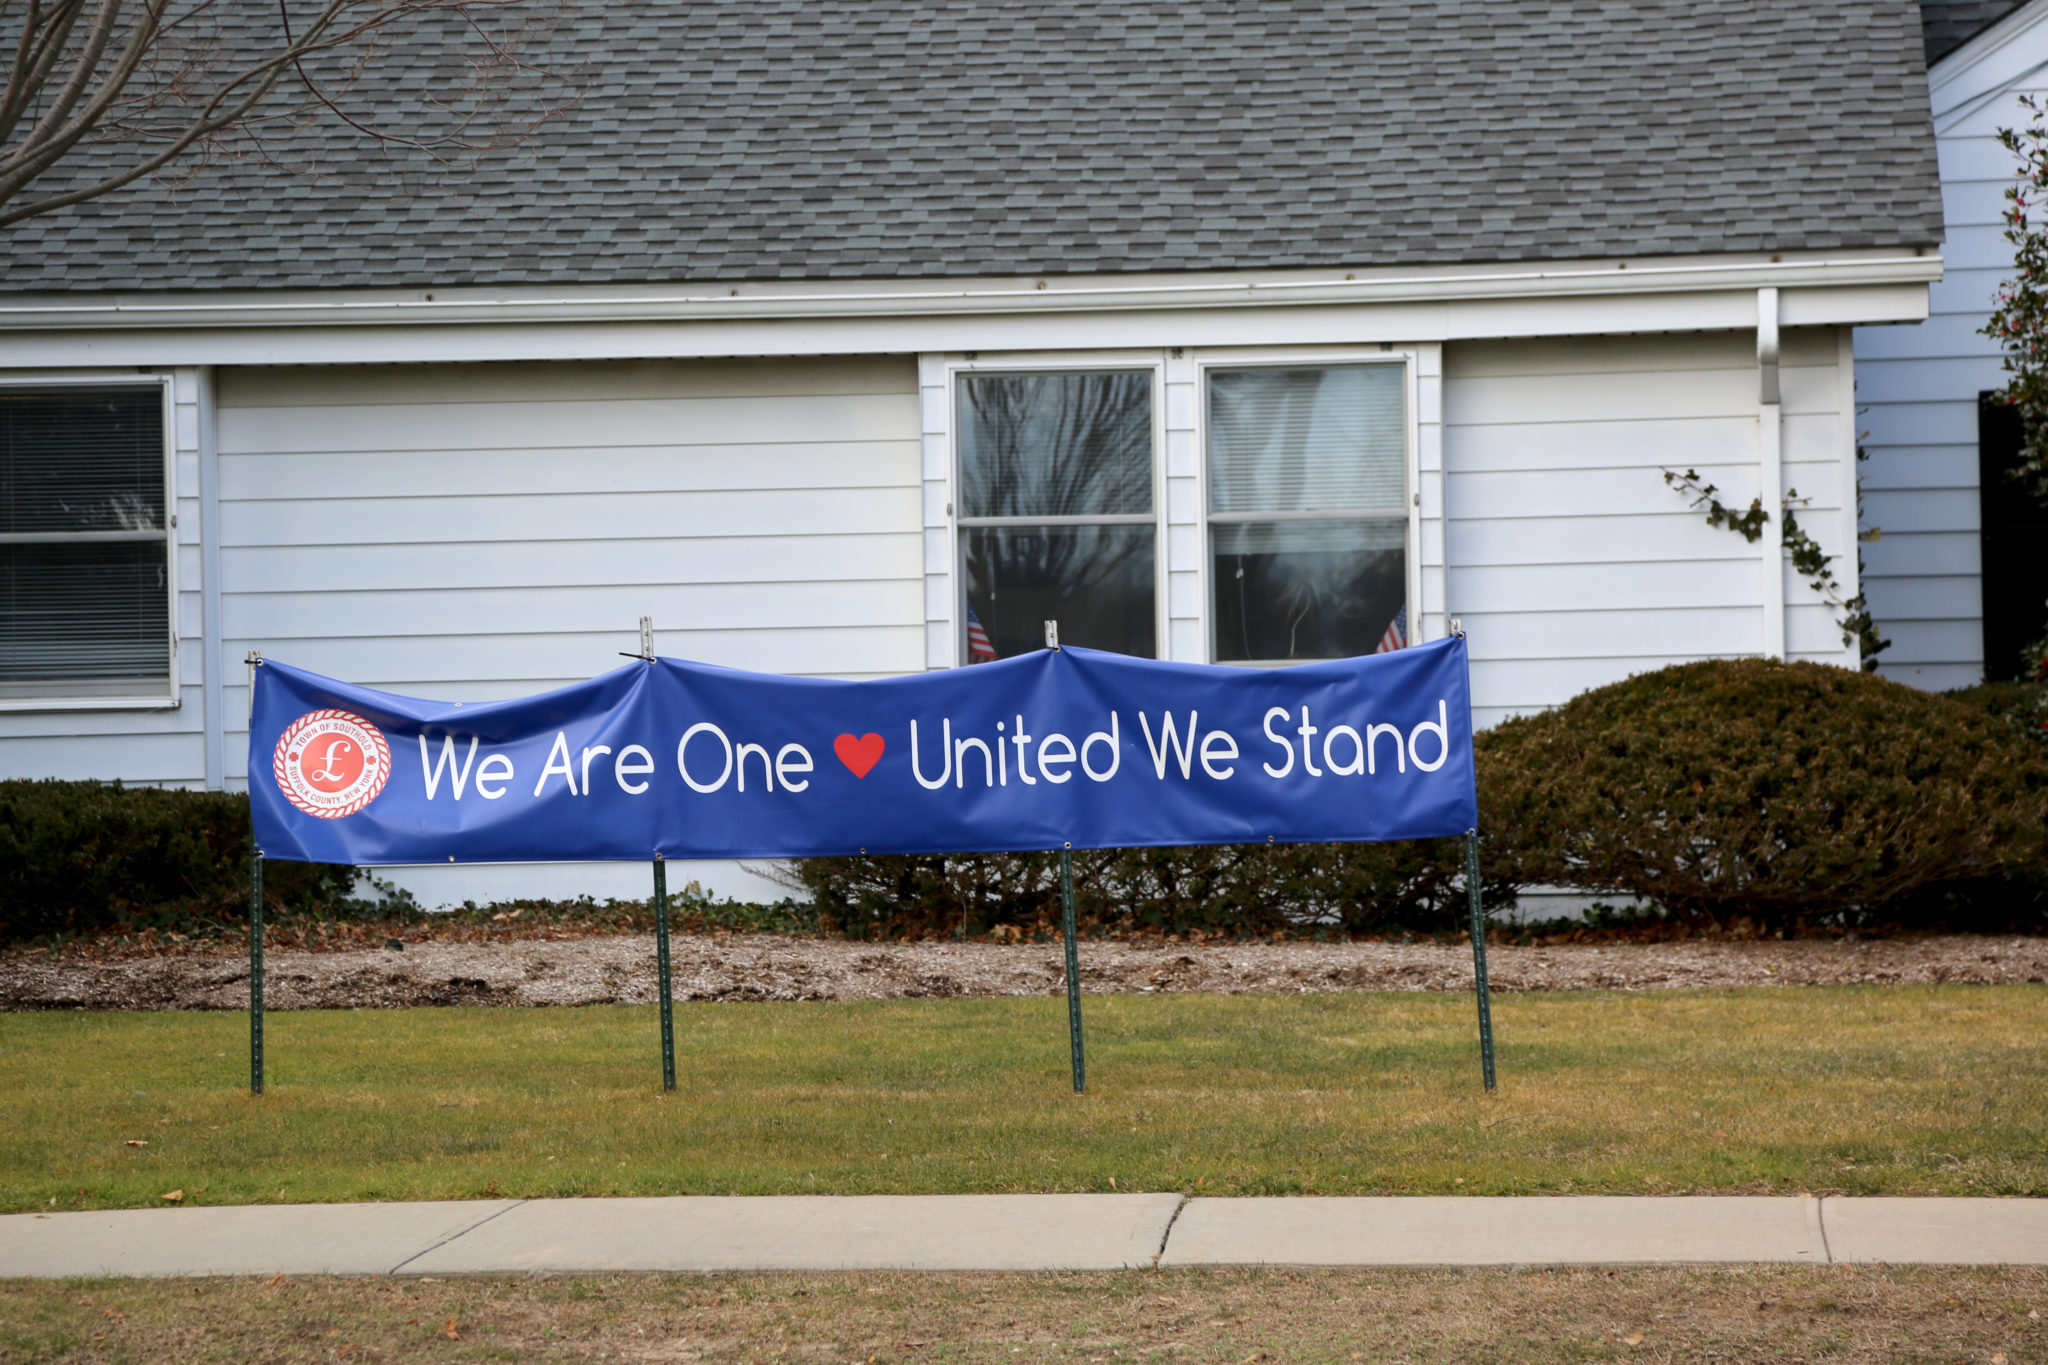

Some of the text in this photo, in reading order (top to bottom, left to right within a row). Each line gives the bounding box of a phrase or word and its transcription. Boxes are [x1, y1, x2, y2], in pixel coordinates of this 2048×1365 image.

[296, 722, 372, 751] TOWN OF SOUTHOLD
[417, 699, 1450, 801] We Are One United We Stand
[289, 766, 311, 797] SUFFOLK
[344, 787, 361, 801] NEW
[359, 768, 374, 789] YORK
